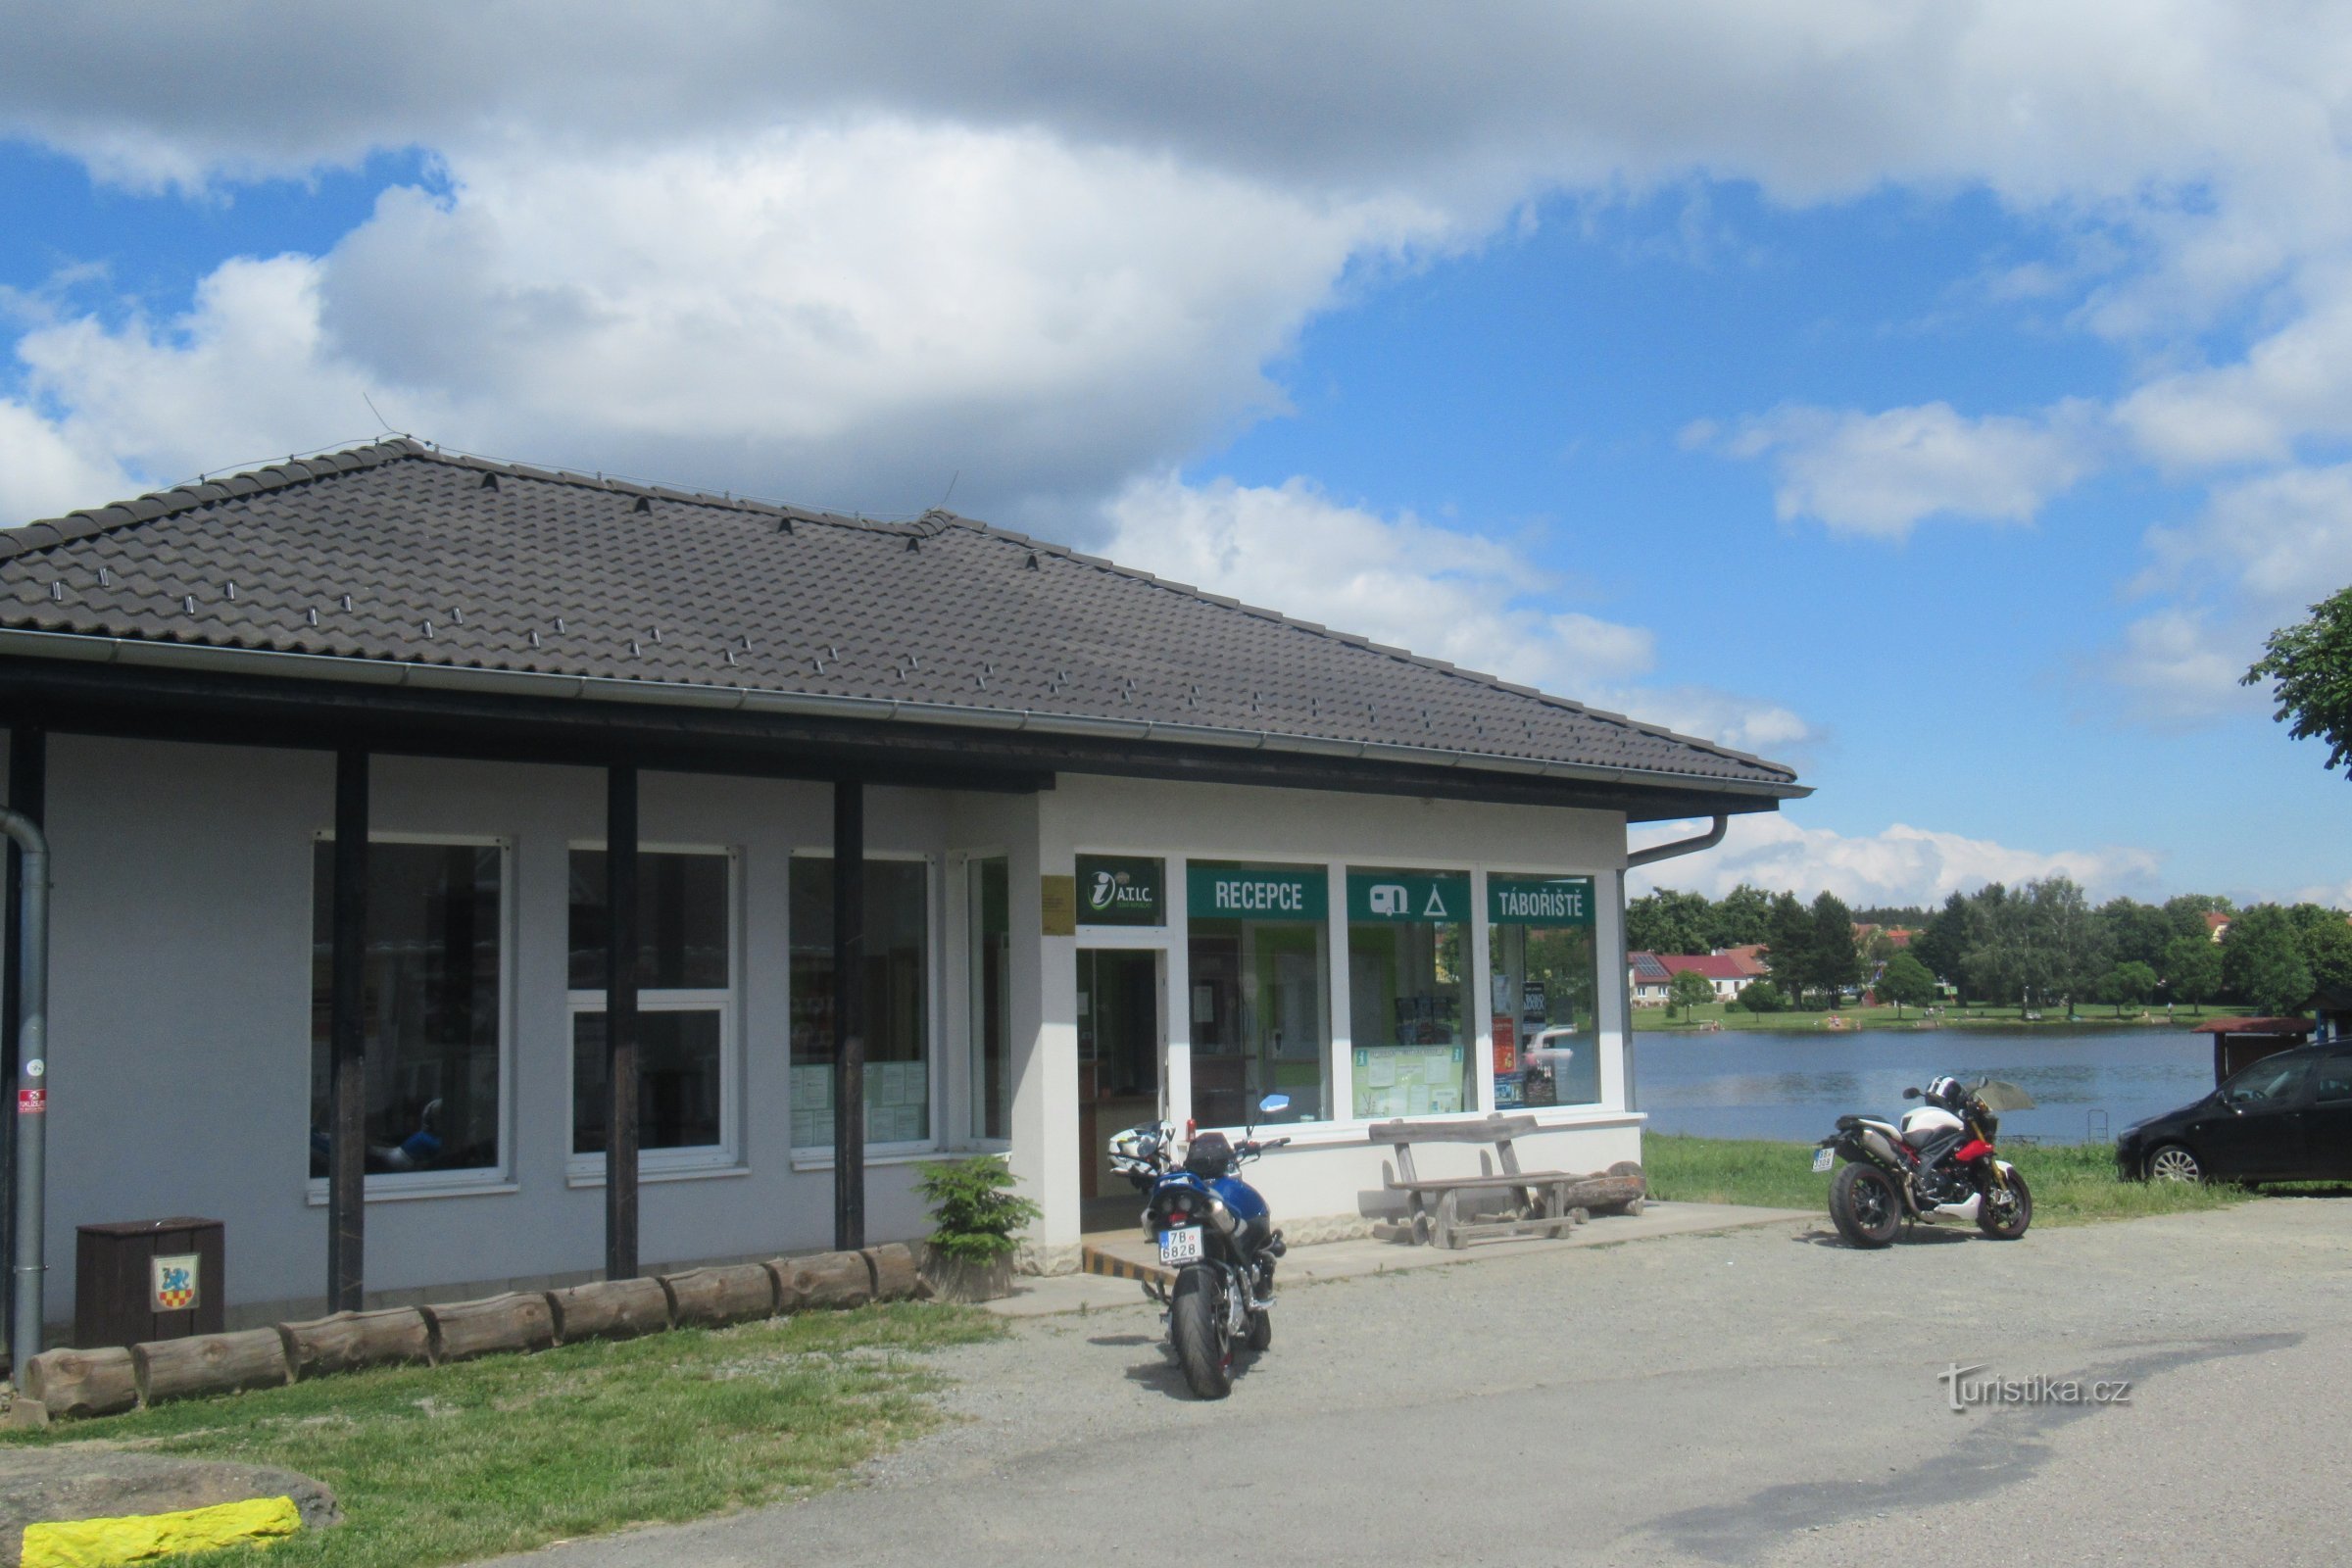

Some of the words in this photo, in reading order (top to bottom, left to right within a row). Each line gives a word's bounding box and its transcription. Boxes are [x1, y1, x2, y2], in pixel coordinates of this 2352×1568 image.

[1116, 887, 1152, 902] A.T.I.C.
[1215, 881, 1302, 909] RECEPCE
[1498, 887, 1583, 917] TÁBOŘIŠTĚ
[1171, 1231, 1186, 1245] 7B
[1163, 1244, 1196, 1258] 6828
